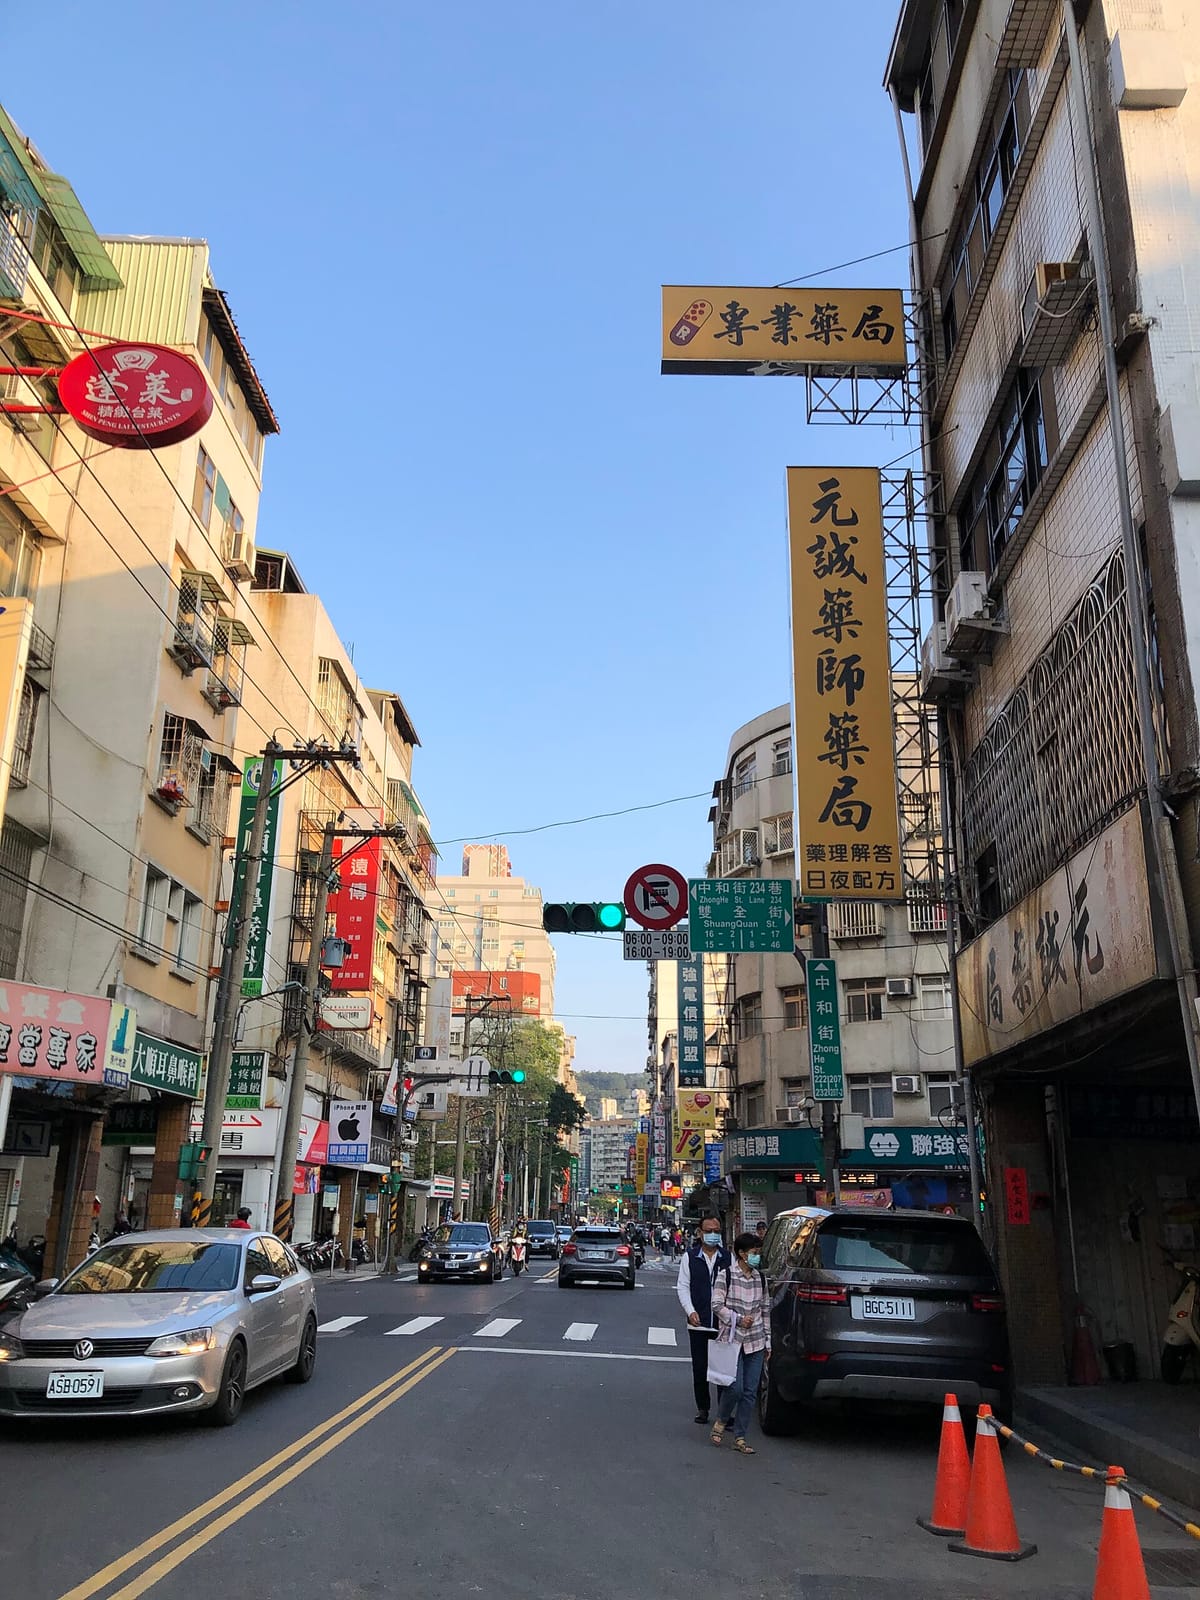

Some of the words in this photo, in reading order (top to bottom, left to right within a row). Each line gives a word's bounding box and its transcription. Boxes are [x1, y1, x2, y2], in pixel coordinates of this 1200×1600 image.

[713, 300, 895, 346] 專業藥局
[806, 477, 872, 833] 元誠藥師藥局
[806, 843, 893, 864] 藥理解答
[350, 858, 368, 901] 遠傳
[698, 881, 783, 895] 中和街234巷
[807, 869, 895, 891] 日夜配方
[698, 905, 783, 919] 雙全街
[703, 920, 759, 929] ShuangQuan
[815, 976, 835, 1041] 中和街
[813, 1043, 840, 1055] Zhong
[813, 1054, 825, 1064] He
[132, 1042, 198, 1091] 大順耳鼻喉科
